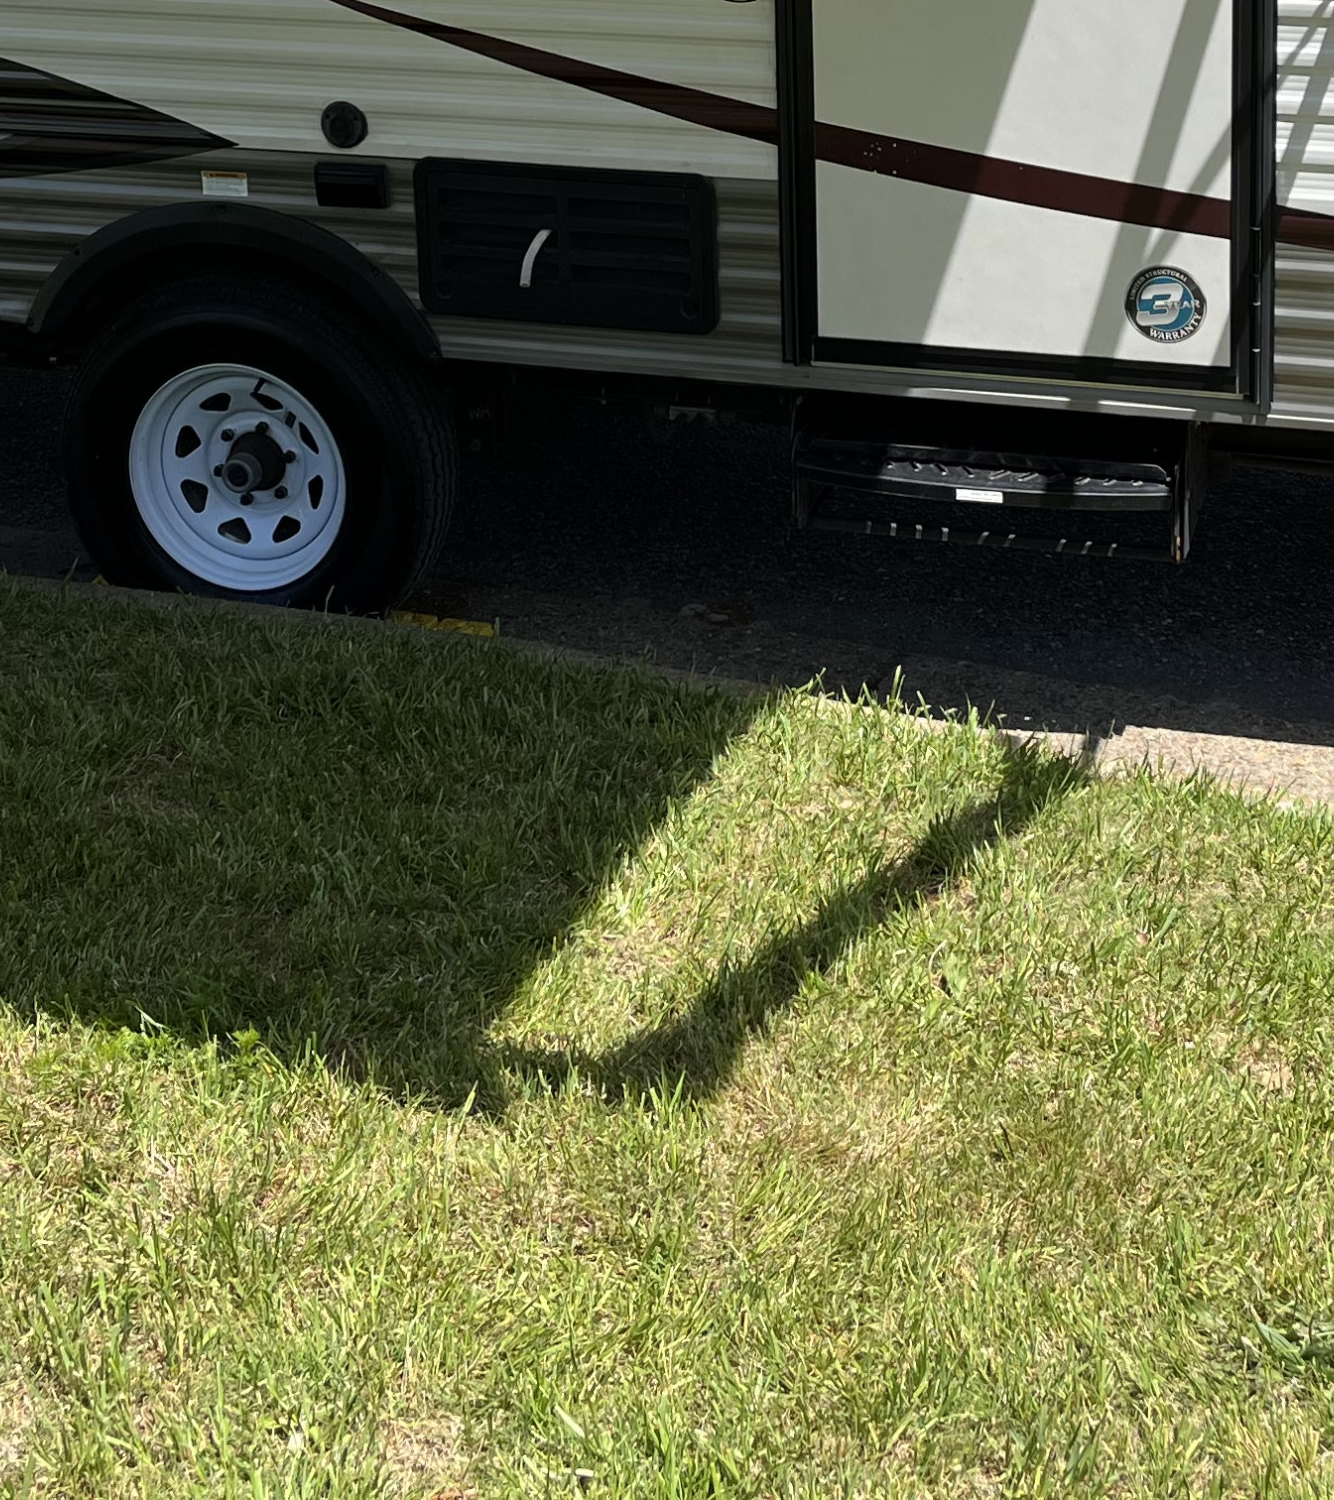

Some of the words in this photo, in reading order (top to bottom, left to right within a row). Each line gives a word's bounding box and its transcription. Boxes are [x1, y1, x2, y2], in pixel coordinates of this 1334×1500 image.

[1145, 268, 1188, 282] STRUCTURAL
[1136, 282, 1184, 327] 3
[1166, 299, 1201, 310] YEAR
[1149, 312, 1202, 341] WARRANTY
